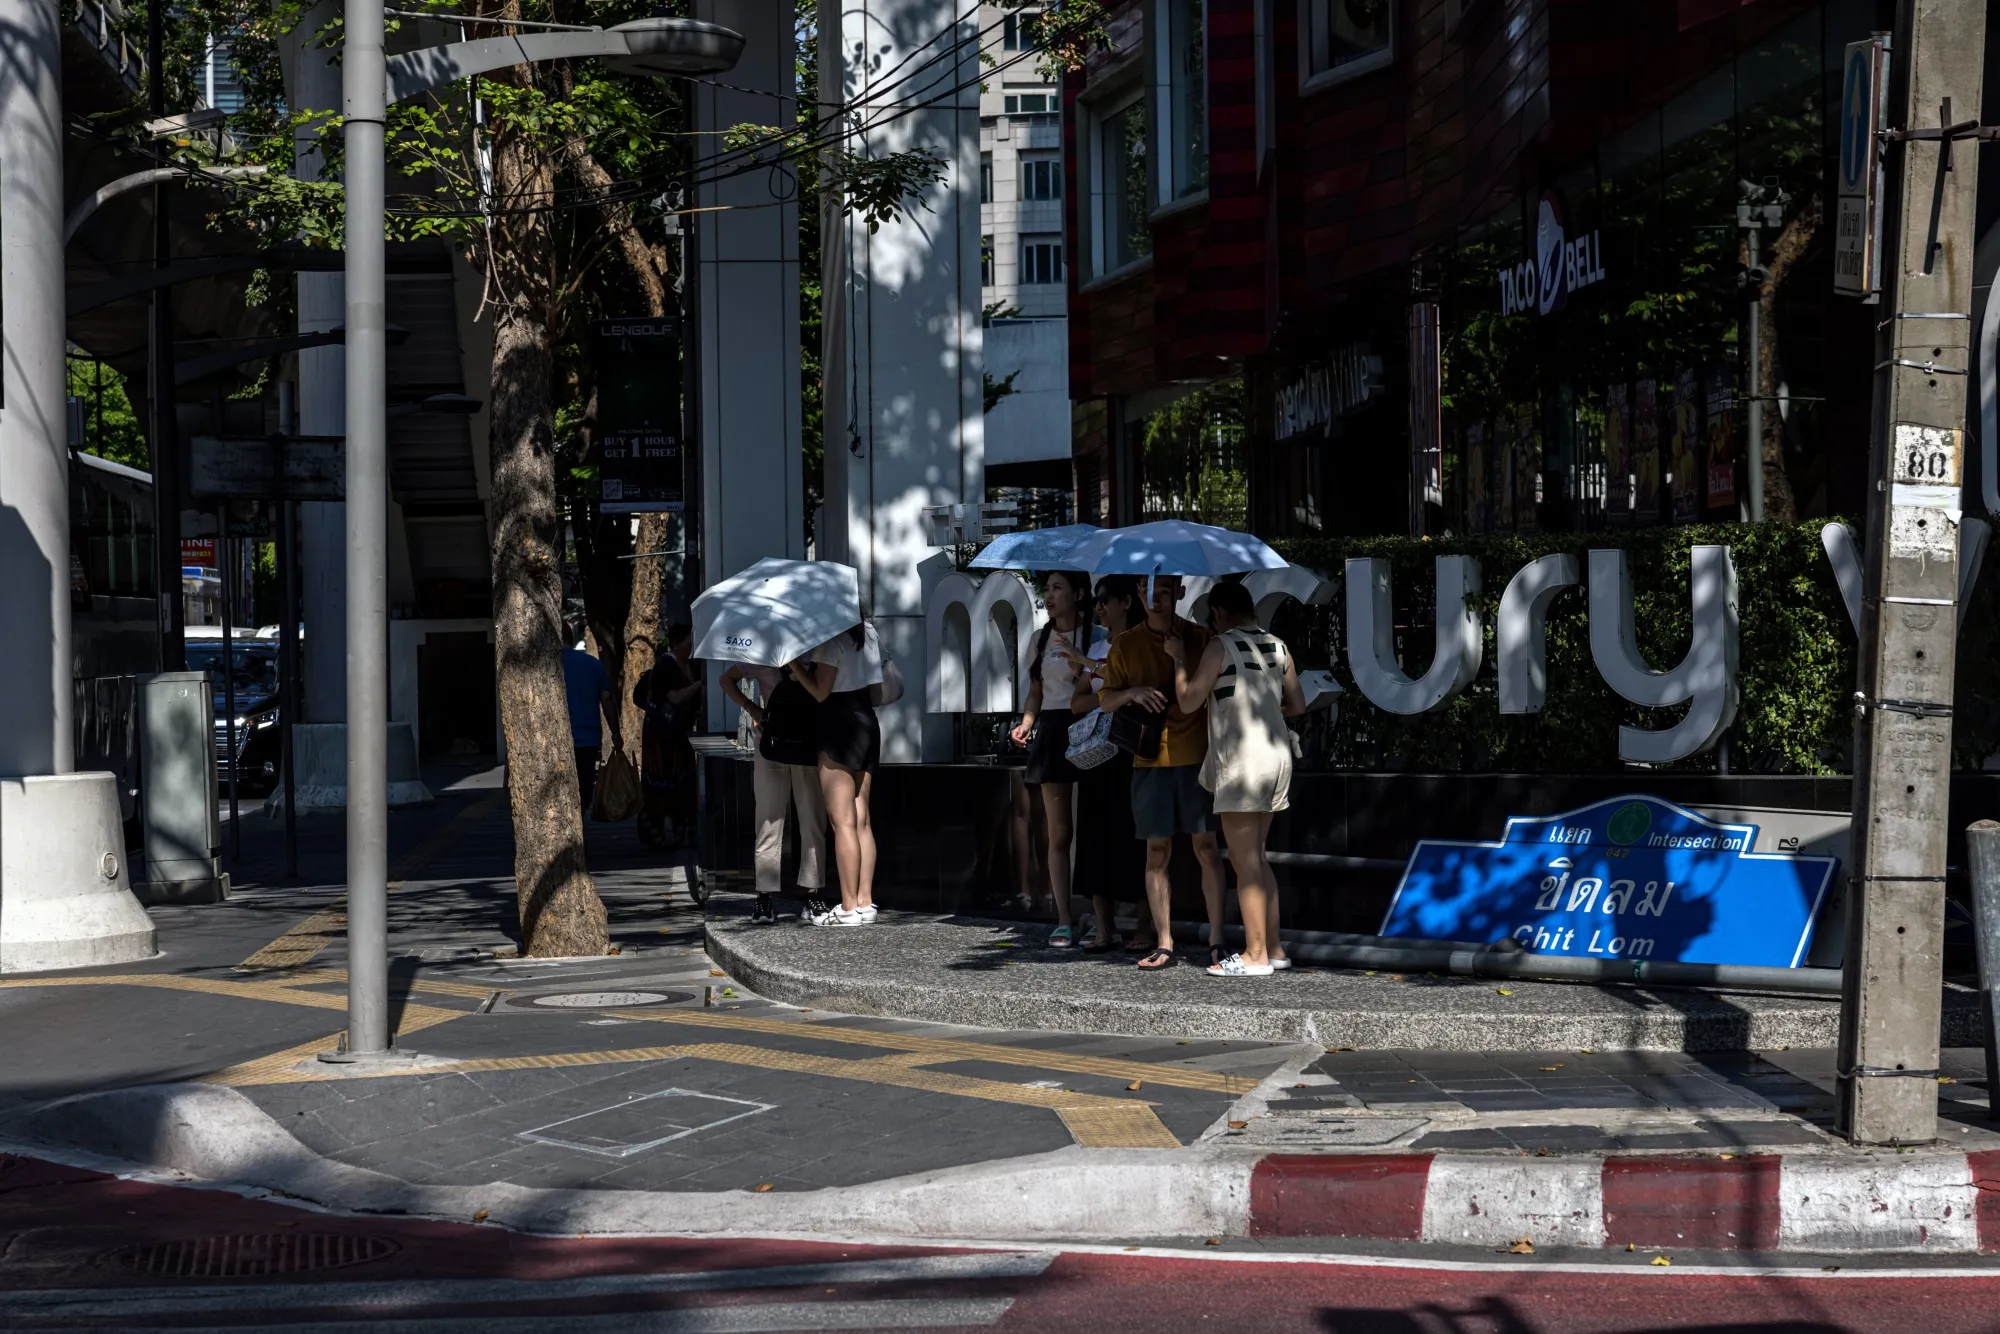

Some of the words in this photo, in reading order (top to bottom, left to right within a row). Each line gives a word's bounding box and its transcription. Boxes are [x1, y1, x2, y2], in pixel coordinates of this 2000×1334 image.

[1499, 258, 1536, 317] TACO
[1565, 228, 1605, 293] BELL
[601, 325, 672, 337] LENGOLF
[604, 436, 626, 446] BUY
[631, 437, 641, 458] 1
[644, 436, 676, 445] HOUR
[604, 448, 627, 458] GET
[644, 448, 676, 457] FREE!
[1908, 451, 1946, 479] 80
[922, 502, 1018, 547] THE
[725, 636, 752, 647] SAXO
[1549, 825, 1592, 846] แยก
[1648, 831, 1742, 850] Intersection
[1535, 857, 1675, 917] ชิดลม
[1513, 925, 1575, 951] Chit
[1588, 931, 1655, 956] Lom
